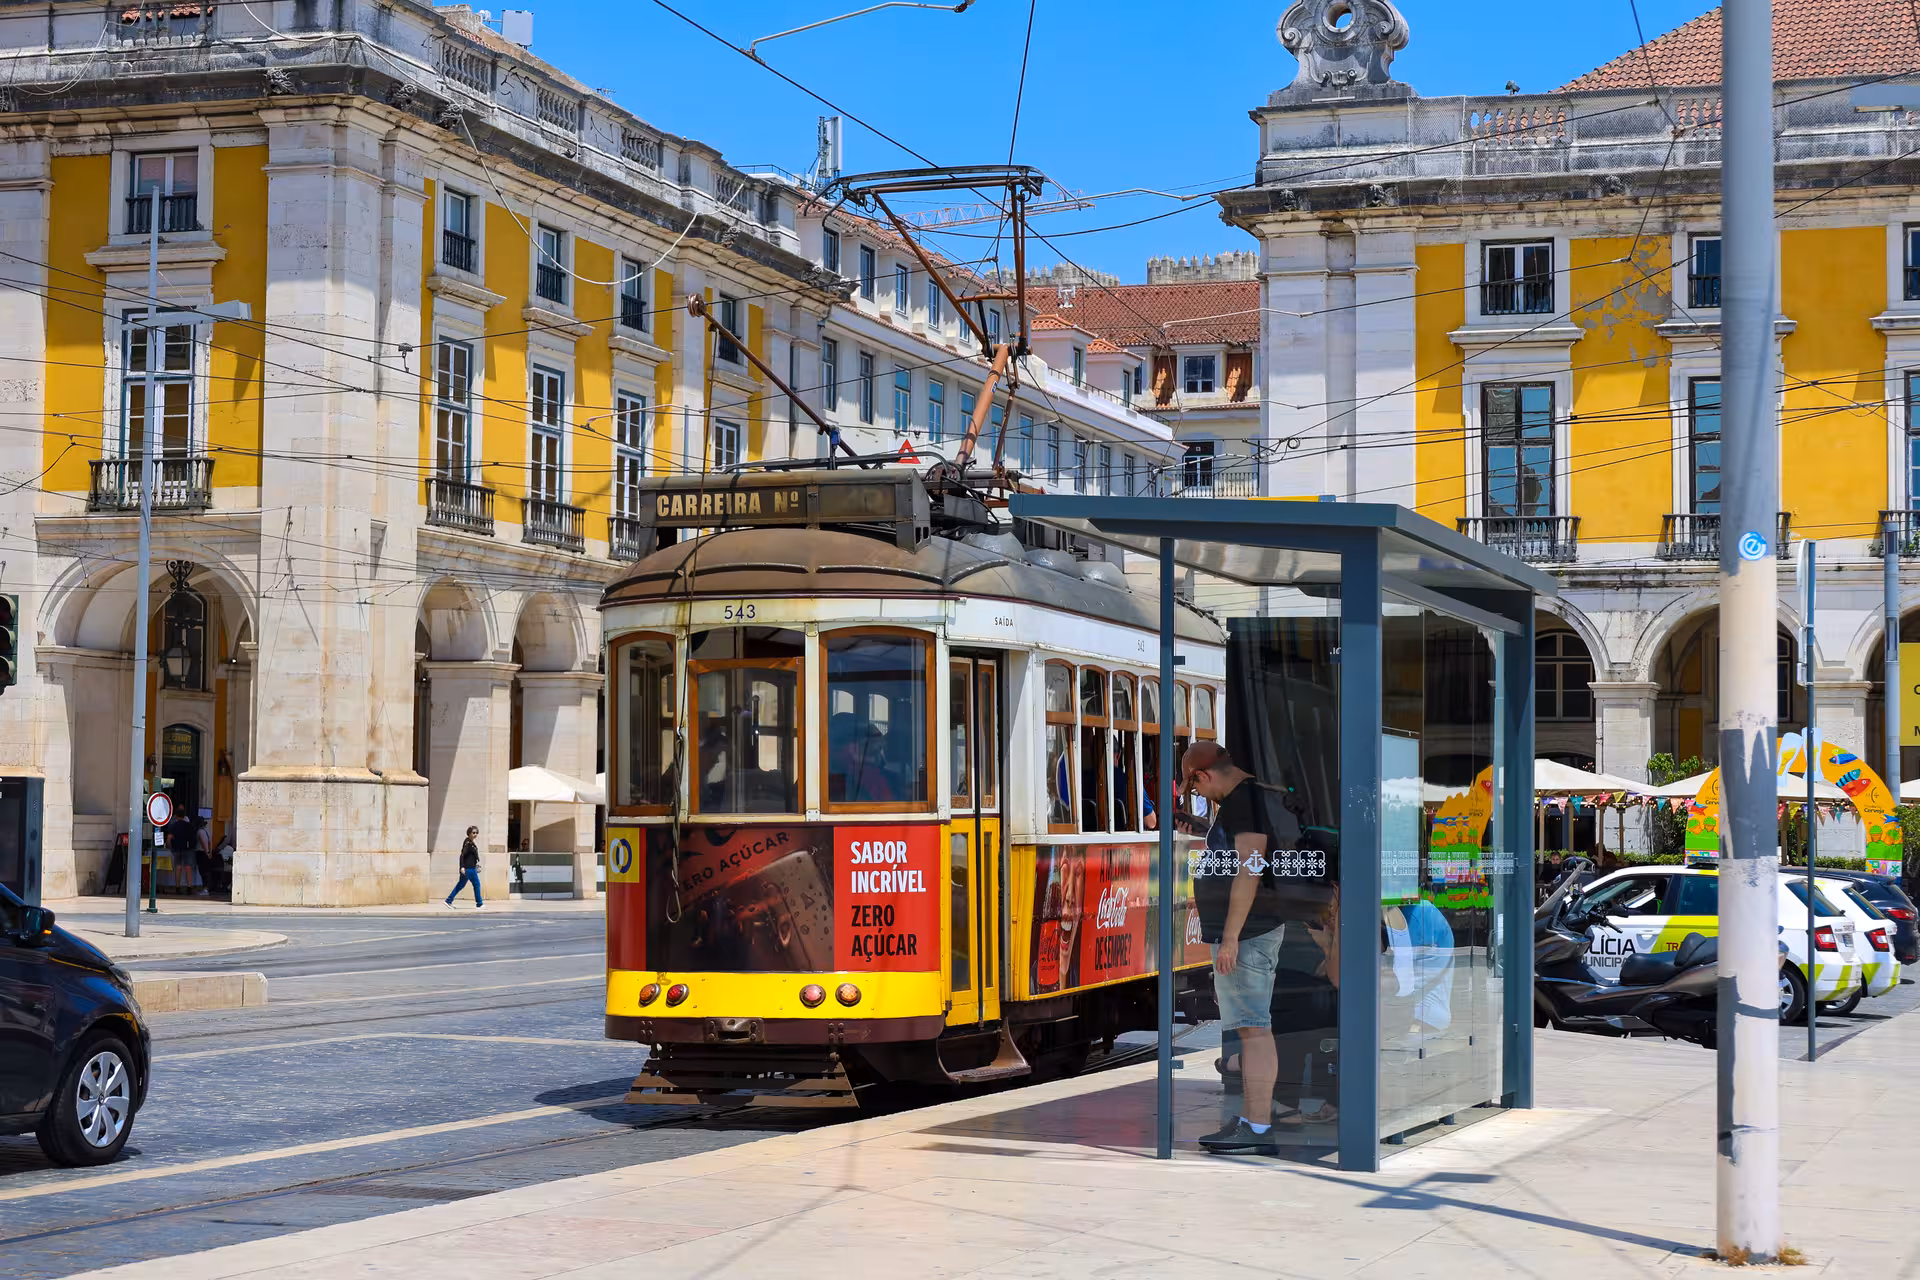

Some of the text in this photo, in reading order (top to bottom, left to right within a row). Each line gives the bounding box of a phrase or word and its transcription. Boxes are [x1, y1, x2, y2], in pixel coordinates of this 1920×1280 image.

[656, 490, 799, 517] CARREIRA Nº
[724, 604, 756, 620] 543
[719, 831, 790, 873] AÇÚCAR
[850, 840, 908, 864] SABOR
[851, 865, 926, 894] INCRÍVEL
[851, 904, 895, 927] ZERO
[851, 928, 917, 963] AÇÚCAR
